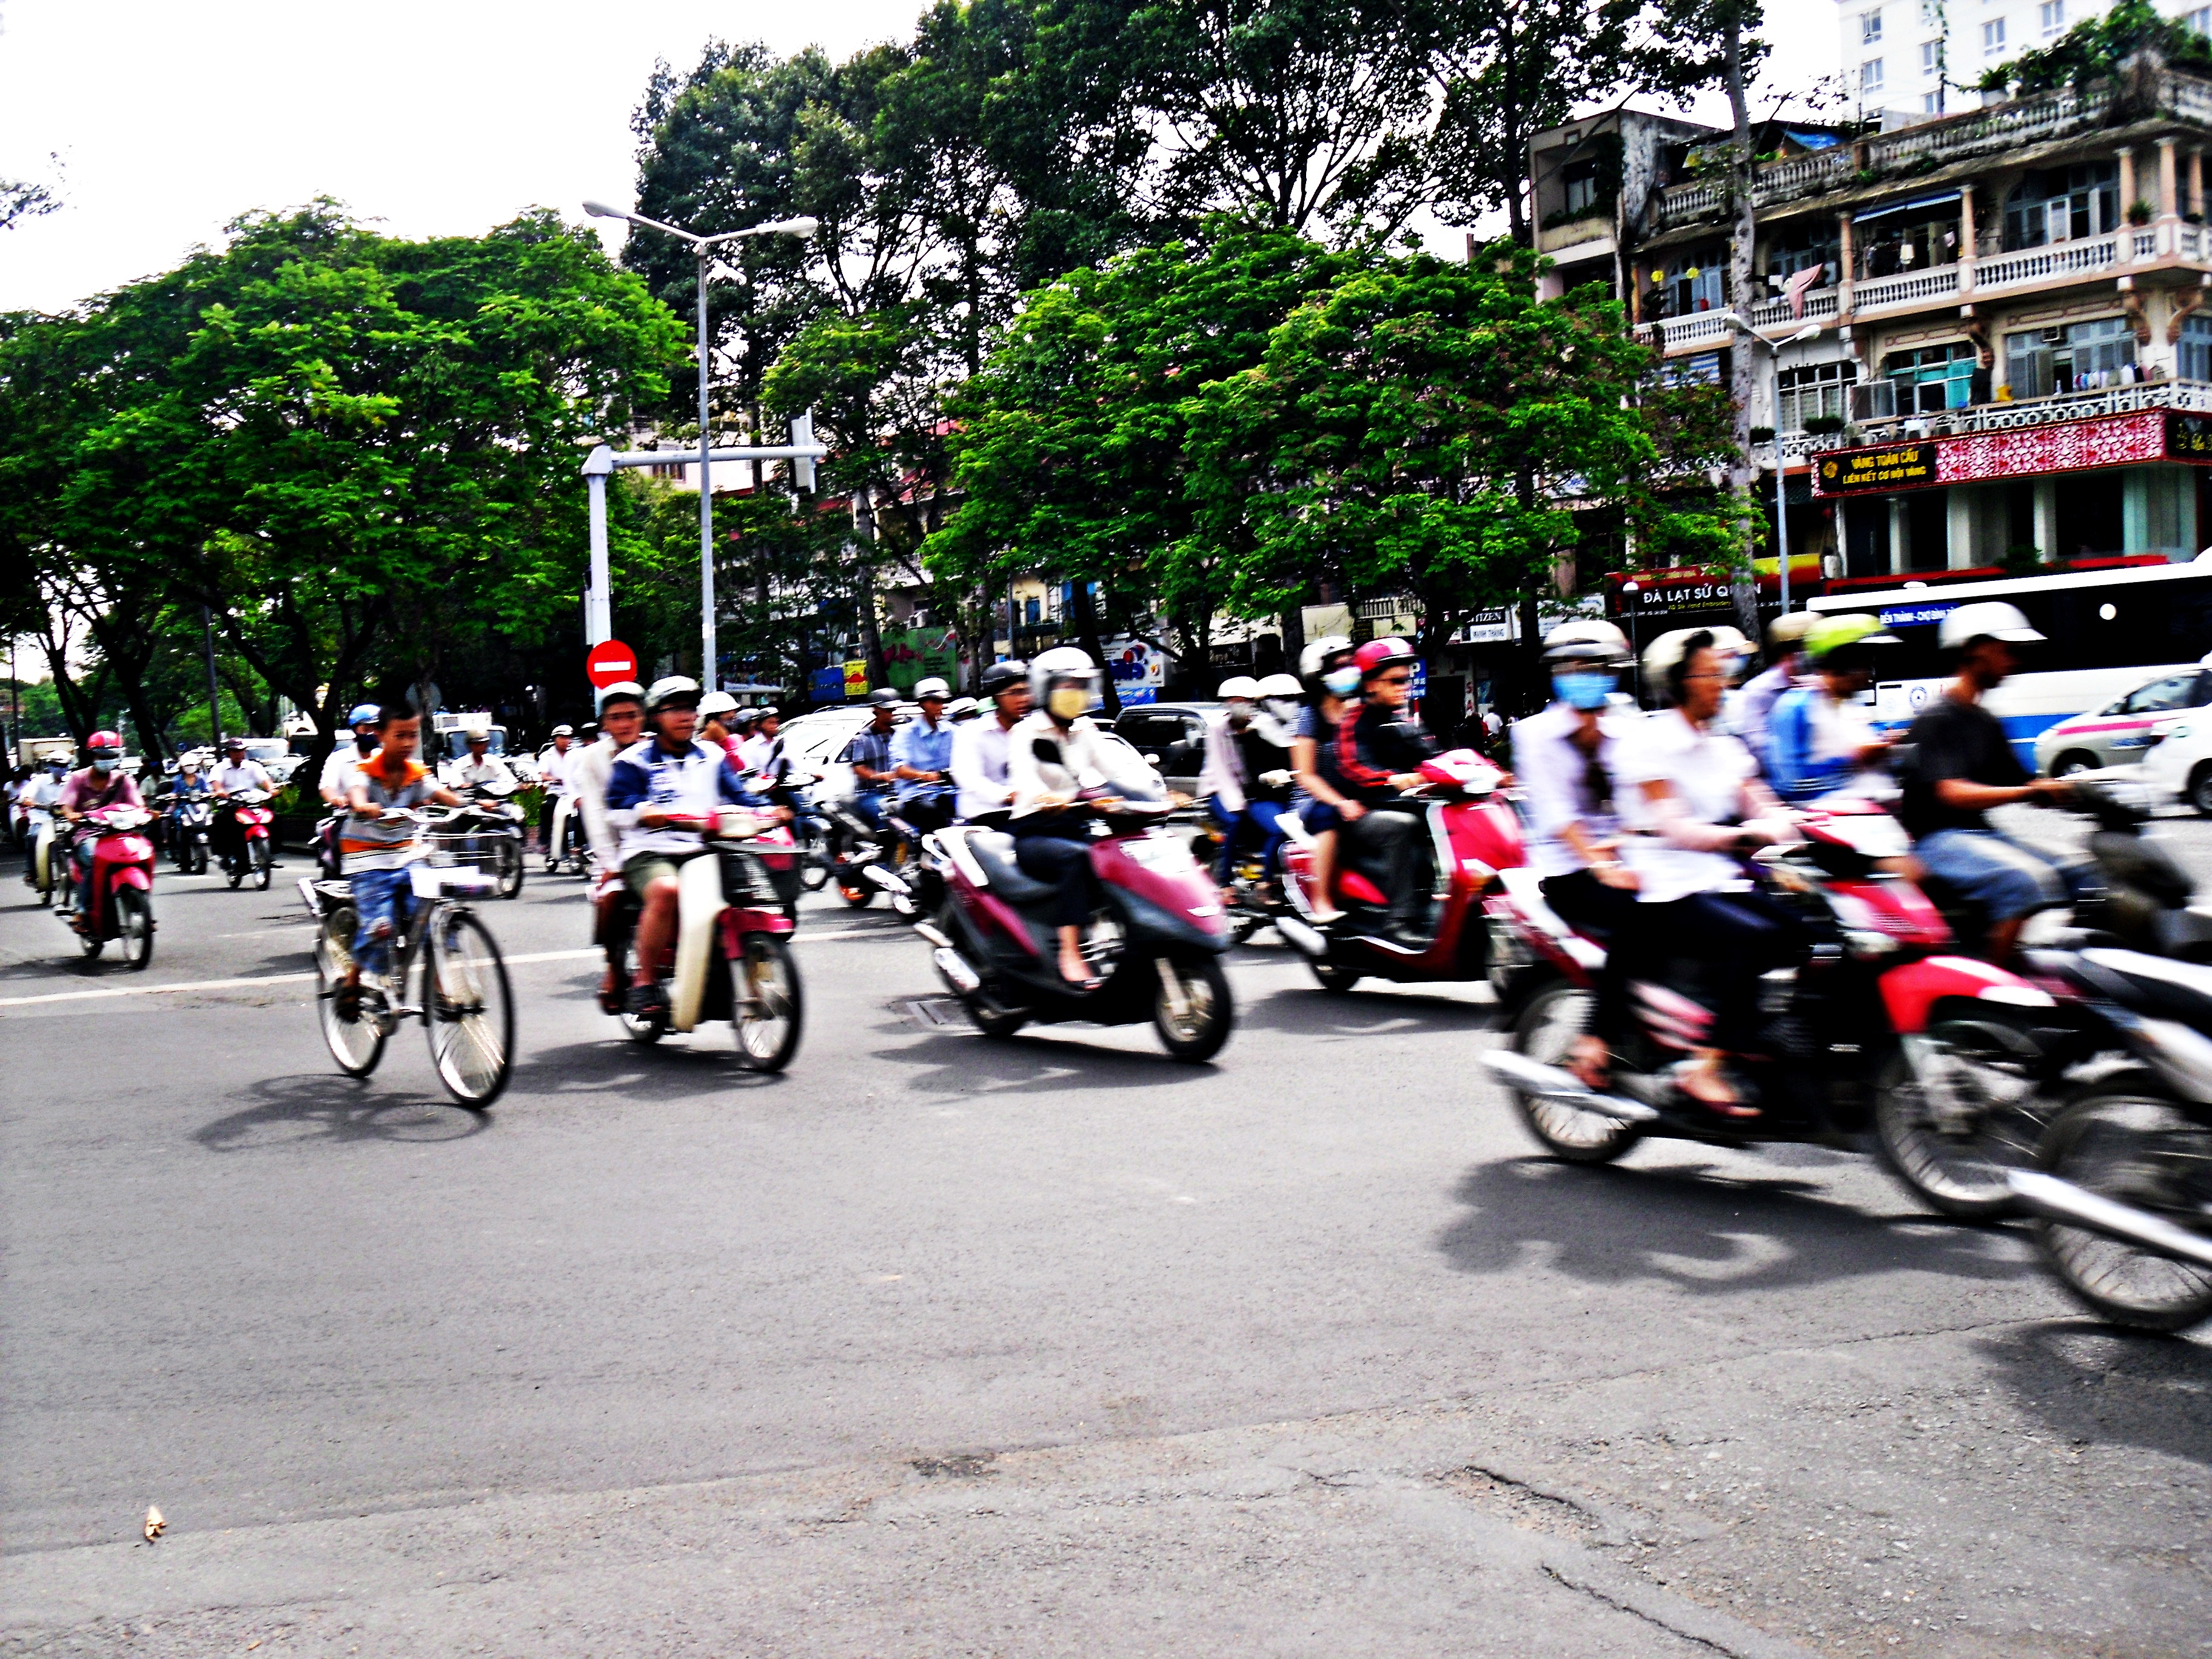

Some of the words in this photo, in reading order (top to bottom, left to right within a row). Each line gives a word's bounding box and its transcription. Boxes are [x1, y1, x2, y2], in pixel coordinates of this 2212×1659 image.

[1643, 588, 1663, 603] ĐÀ
[1667, 588, 1691, 603] LẠT
[1694, 583, 1712, 599] SỬ
